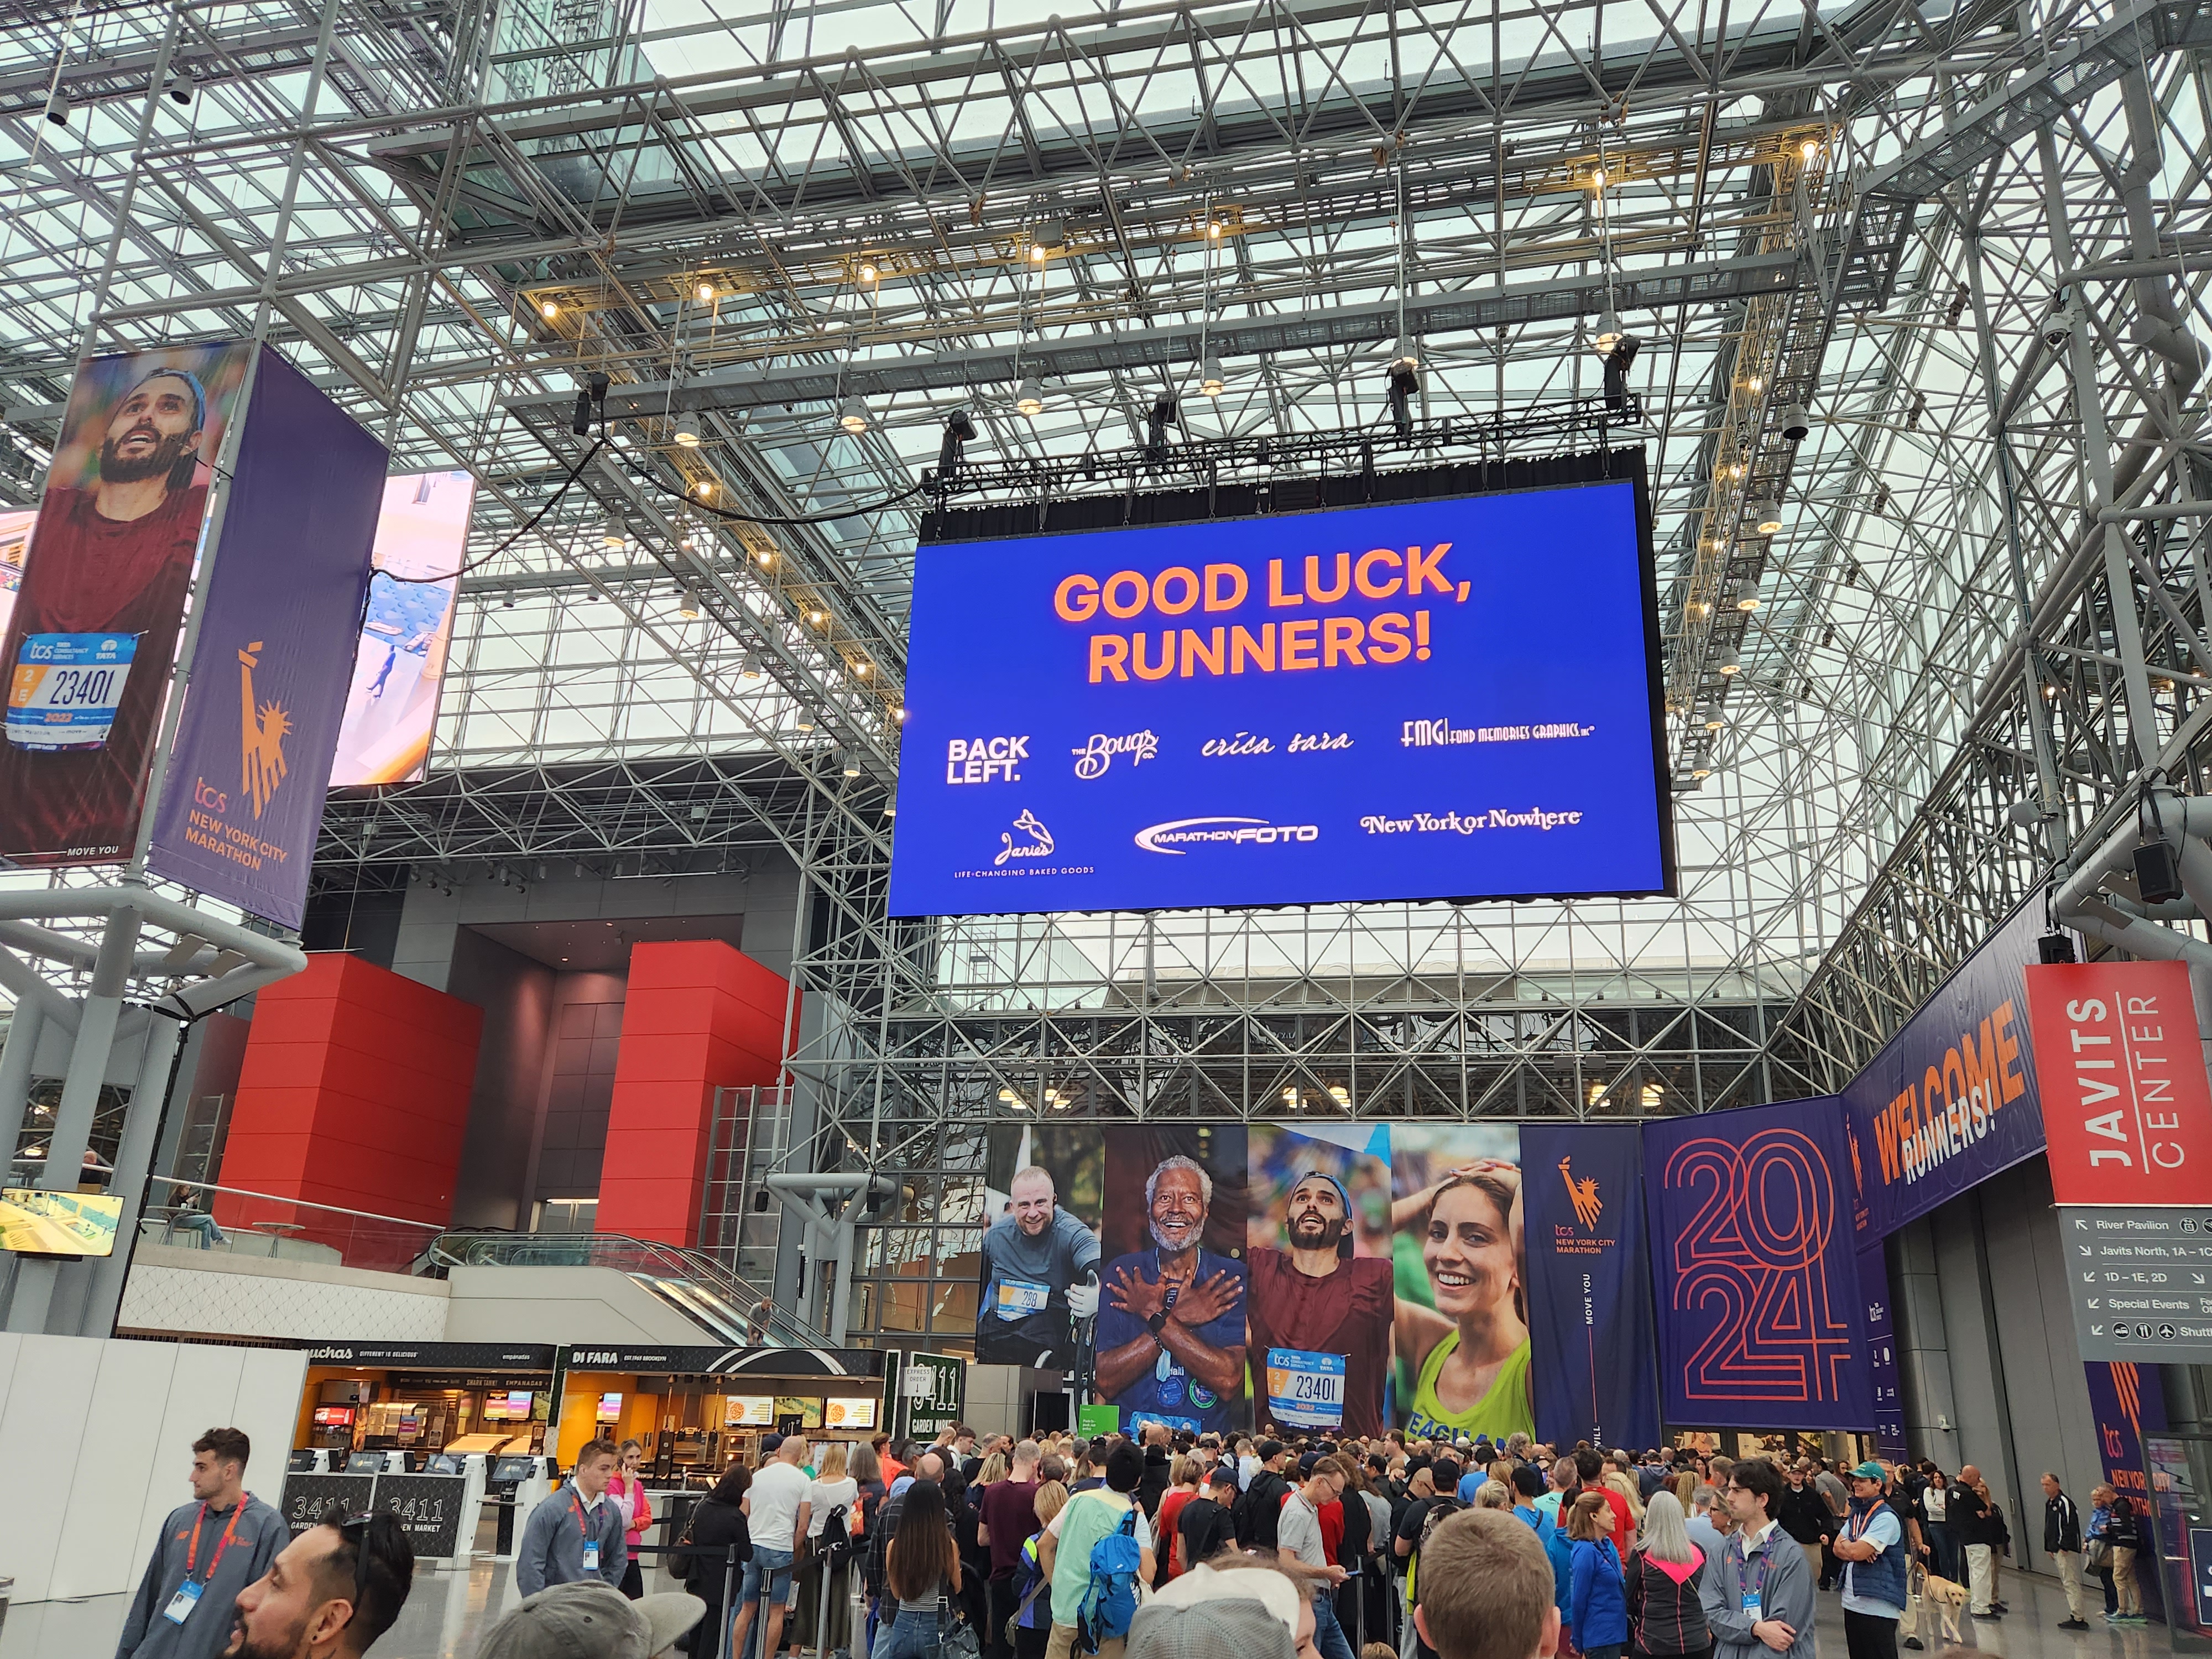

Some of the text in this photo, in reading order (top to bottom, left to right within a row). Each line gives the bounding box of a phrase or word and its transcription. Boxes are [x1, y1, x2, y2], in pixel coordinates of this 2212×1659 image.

[1055, 541, 1471, 623] GOOD LUCK,
[30, 643, 54, 659] tcs
[1088, 610, 1431, 683] RUNNERS!
[24, 670, 34, 682] 2
[49, 670, 115, 705] 23401
[18, 690, 28, 702] E
[1202, 732, 1354, 757] erica sara
[1449, 729, 1475, 744] FOND
[1478, 726, 1530, 742] MEMORIES
[948, 736, 1030, 761] BACK
[947, 759, 1021, 784] LEFT.
[195, 776, 228, 813] tcs
[1360, 807, 1582, 834] New York or Nowhere
[190, 809, 288, 863] NEW YORK CITY
[67, 846, 118, 857] MOVE YOU
[185, 827, 262, 872] MARATHON
[1874, 998, 2025, 1186] WELCOME
[2067, 997, 2132, 1167] JAVITS
[2127, 996, 2185, 1168] CENTER
[1902, 1078, 1995, 1185] RUNNERS!
[1555, 1224, 1574, 1236] tcs
[2096, 1220, 2169, 1230] River Pavilion
[2100, 1246, 2132, 1255] Javits
[2135, 1246, 2169, 1257] North,
[2172, 1248, 2187, 1256] 1A
[2104, 1272, 2119, 1281] 1D
[2132, 1273, 2148, 1283] 1E,
[2151, 1273, 2167, 1282] 2D
[1021, 1291, 1037, 1307] 288
[1583, 1274, 1594, 1324] MOVE YOU
[2109, 1299, 2189, 1310] Special Events
[572, 1352, 586, 1363] DI
[586, 1352, 618, 1364] FARA
[1274, 1354, 1290, 1366] tcs
[1274, 1372, 1280, 1380] 2
[1296, 1375, 1335, 1401] 23401
[1274, 1385, 1280, 1394] E
[912, 1419, 955, 1433] GARDEN MARK
[2111, 1469, 2172, 1493] NEW YOR CITY
[390, 1497, 443, 1522] 3411
